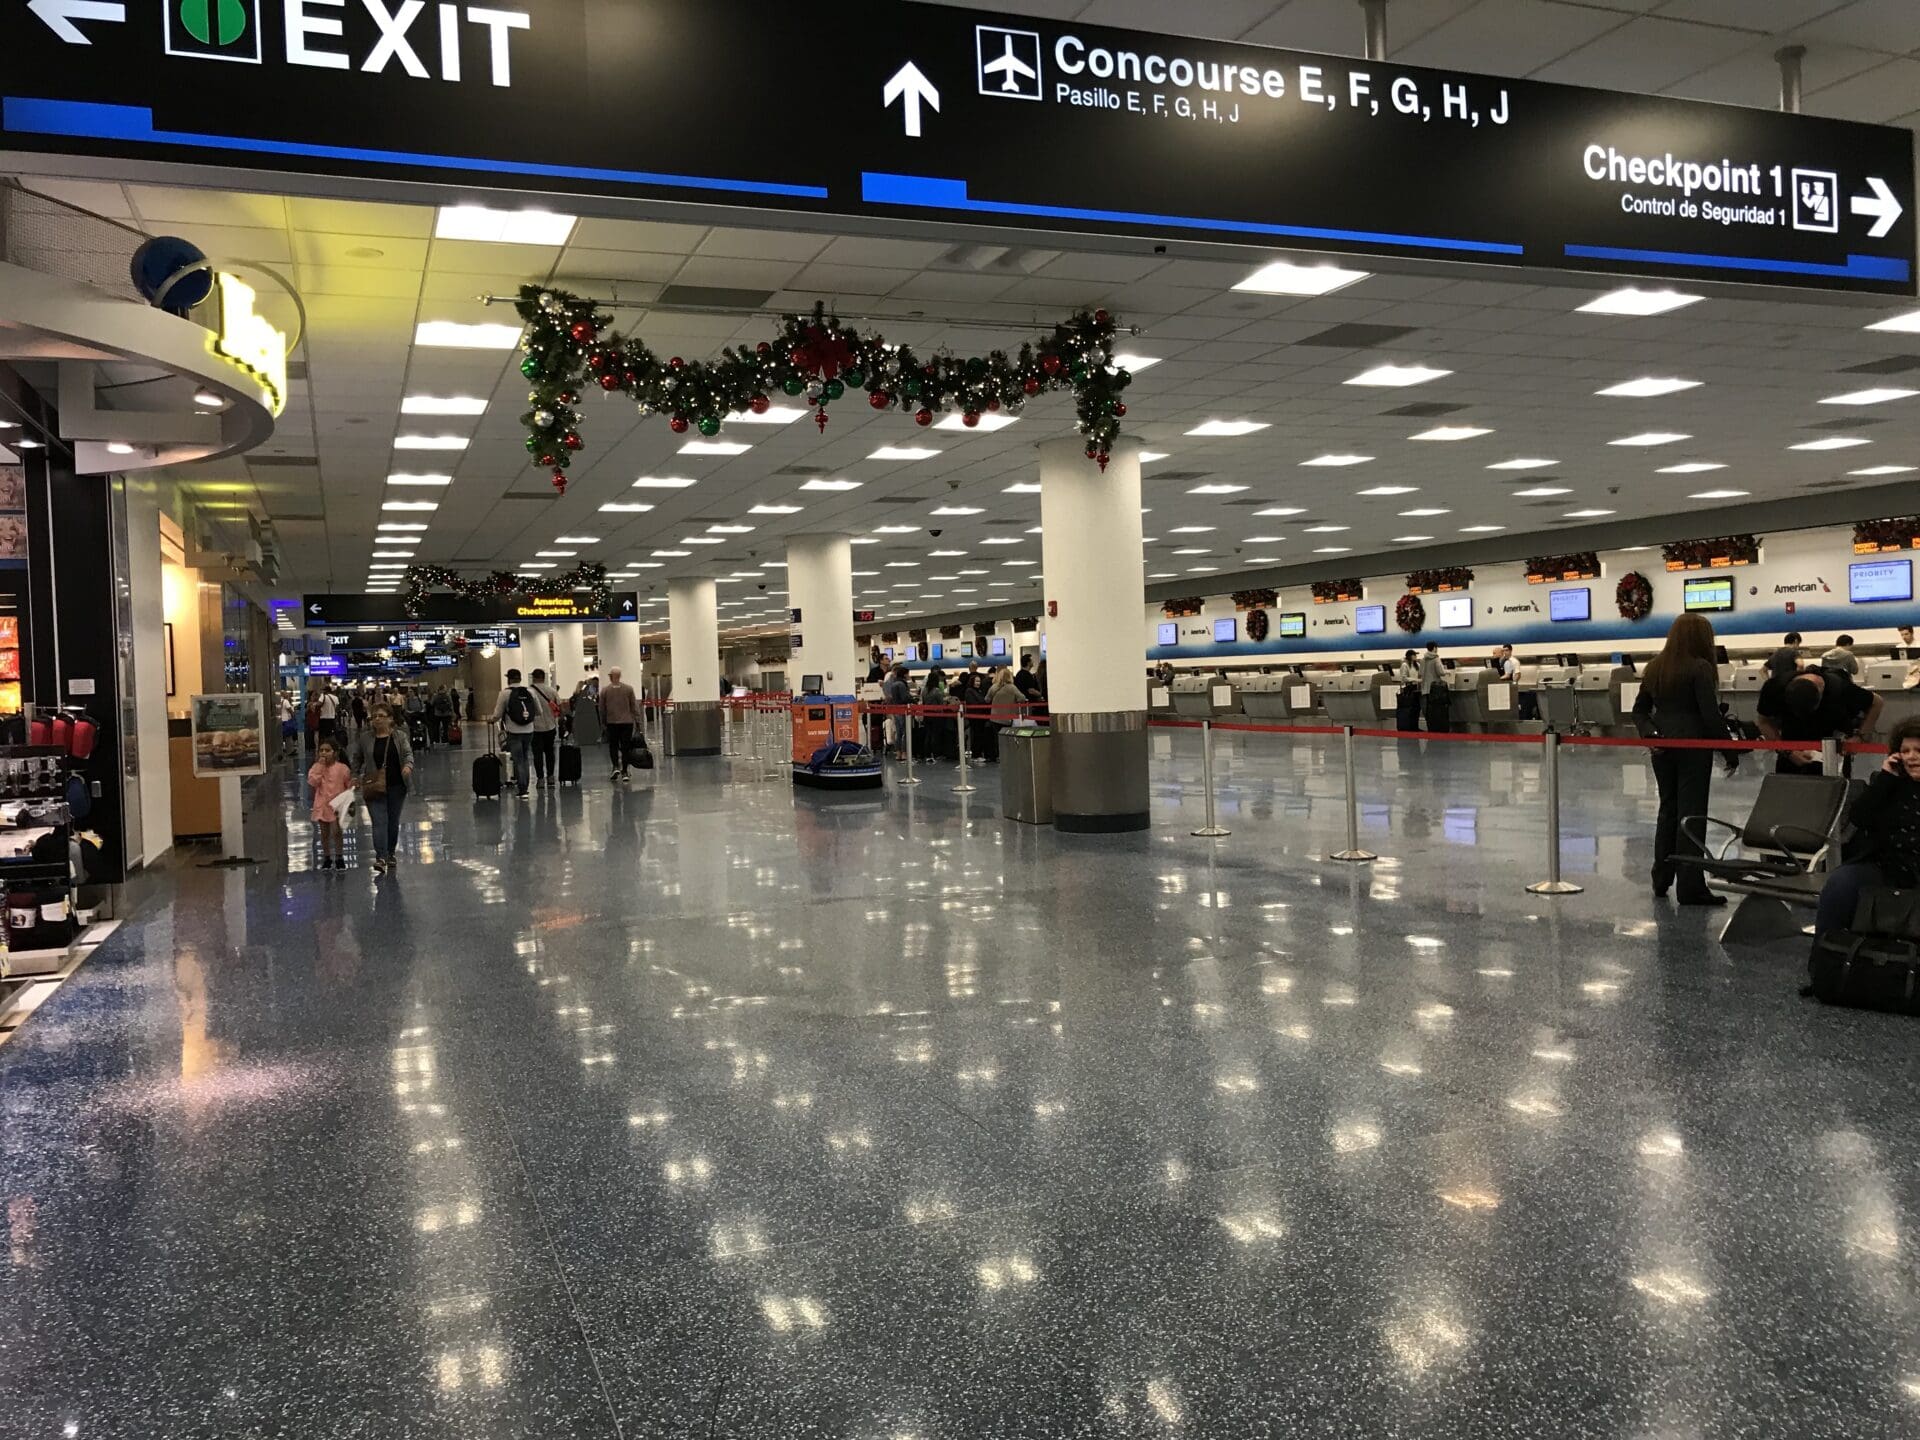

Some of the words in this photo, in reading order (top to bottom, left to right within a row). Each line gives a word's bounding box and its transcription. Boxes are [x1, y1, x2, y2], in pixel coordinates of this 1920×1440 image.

[285, 0, 531, 88] EXIT
[1056, 36, 1286, 99] Concourse
[1298, 66, 1336, 112] E,
[1348, 72, 1379, 116] F,
[1391, 78, 1431, 122] G,
[1443, 84, 1479, 128] H,
[1490, 91, 1509, 124] J
[1056, 84, 1121, 109] Pasillo
[1127, 91, 1147, 115] E,
[1153, 94, 1169, 118] F,
[1174, 96, 1197, 121] G,
[1202, 98, 1223, 124] H,
[1228, 104, 1240, 123] J
[1583, 144, 1761, 197] Checkpoint
[1769, 165, 1782, 197] 1
[1621, 193, 1676, 217] Control
[1679, 199, 1698, 218] de
[1701, 202, 1775, 228] Seguridad
[1778, 209, 1786, 226] 1
[1853, 569, 1895, 578] PRIORITY
[1774, 582, 1817, 594] American
[533, 597, 574, 606] American
[517, 607, 570, 616] Checkpoints
[571, 607, 578, 615] 2
[583, 607, 590, 615] 4
[1503, 605, 1531, 613] American
[1324, 618, 1345, 626] American
